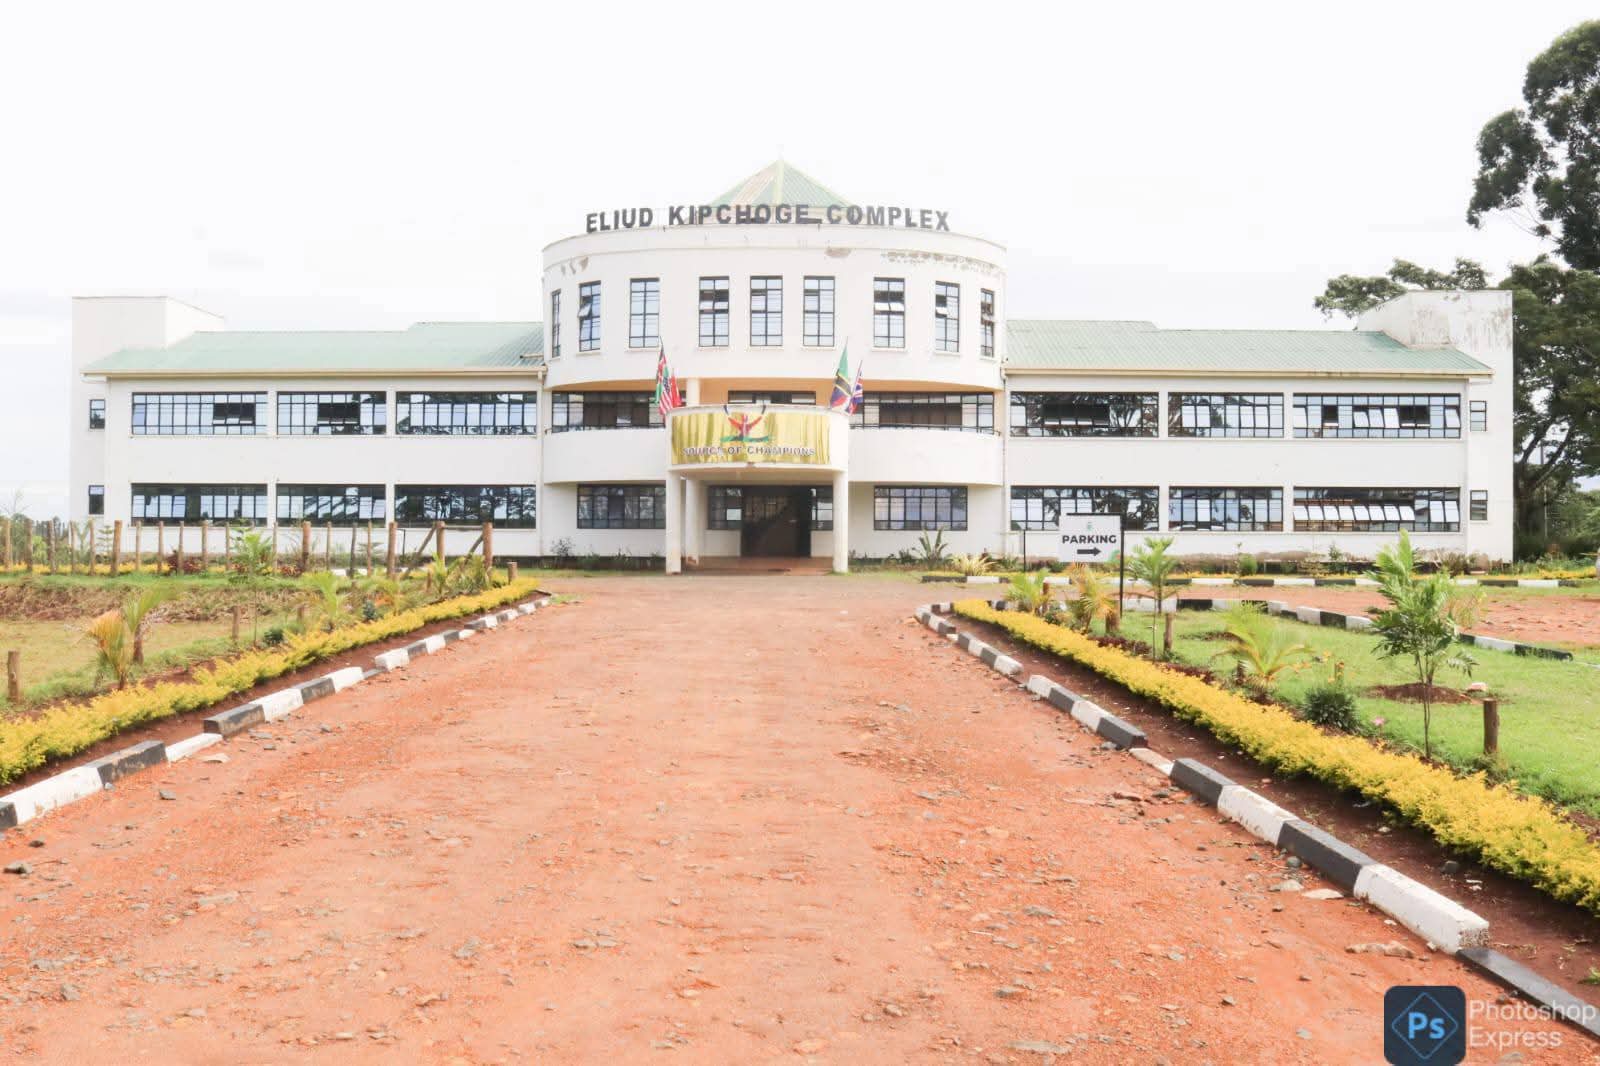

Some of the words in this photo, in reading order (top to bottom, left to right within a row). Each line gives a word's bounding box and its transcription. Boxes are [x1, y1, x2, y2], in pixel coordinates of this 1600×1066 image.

[585, 207, 654, 233] ELIUD
[668, 204, 811, 225] KIPCHOGE
[826, 204, 951, 232] COMPLEX
[683, 446, 723, 457] SOURCE
[727, 446, 742, 455] OF
[747, 446, 815, 457] CHAMPIONS
[1062, 534, 1117, 544] PARKING
